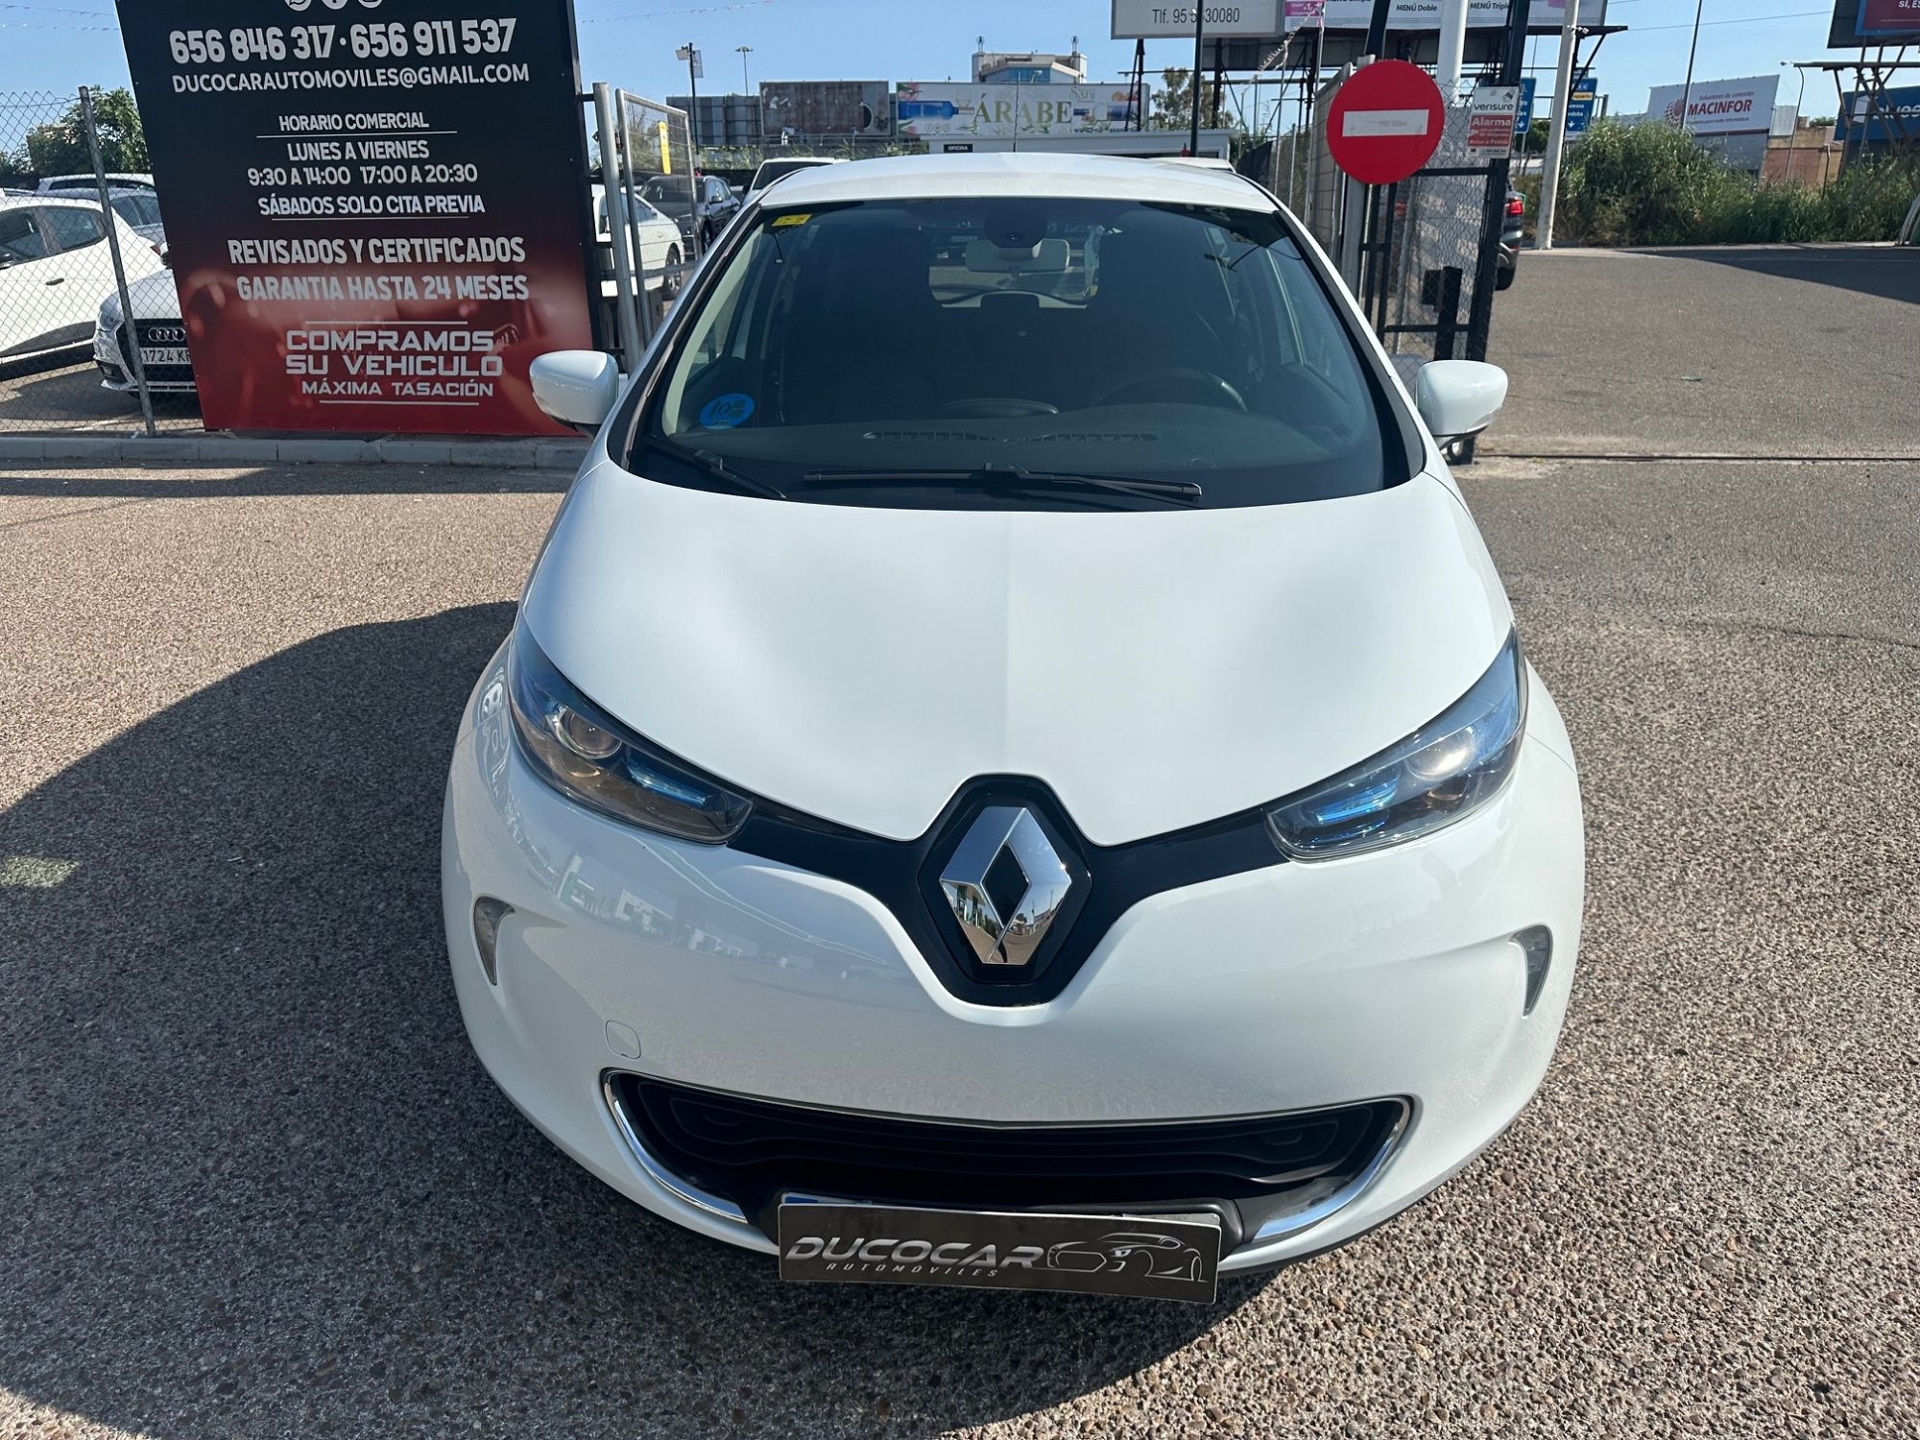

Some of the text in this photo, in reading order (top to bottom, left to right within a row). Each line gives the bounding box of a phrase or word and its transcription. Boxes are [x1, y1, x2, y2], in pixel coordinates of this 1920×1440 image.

[1152, 8, 1240, 23] Tlf. 95 530080
[1396, 2, 1437, 12] MENÚ Doble
[1470, 1, 1491, 10] MENÚ
[169, 17, 517, 65] 656 846 317 656 911 537
[172, 63, 530, 93] DUCOCARAUTOMOVILES@GMAIL.COM
[973, 92, 1073, 124] ÁRABE
[1687, 99, 1753, 116] MACINFOR
[279, 112, 430, 132] HORARIO COMERCIAL
[1471, 117, 1511, 127] Alarma
[287, 140, 430, 162] LUNES A VIERNES
[247, 163, 478, 186] 9:30 A 14:00 17:00 A 20:30
[258, 192, 485, 216] SÁBADOS SOLO CITA PREVIA
[228, 236, 525, 264] REVISADOS Y CERTIFICADOS
[236, 274, 530, 301] GARANTIA HASTA 24 MESES
[286, 330, 494, 352] COMPRAMOS
[143, 350, 174, 362] 1724
[286, 355, 502, 377] SU VEHICULO
[301, 378, 494, 398] MÁXIMA TASACIÓN
[785, 1236, 1044, 1268] DUCOCAR
